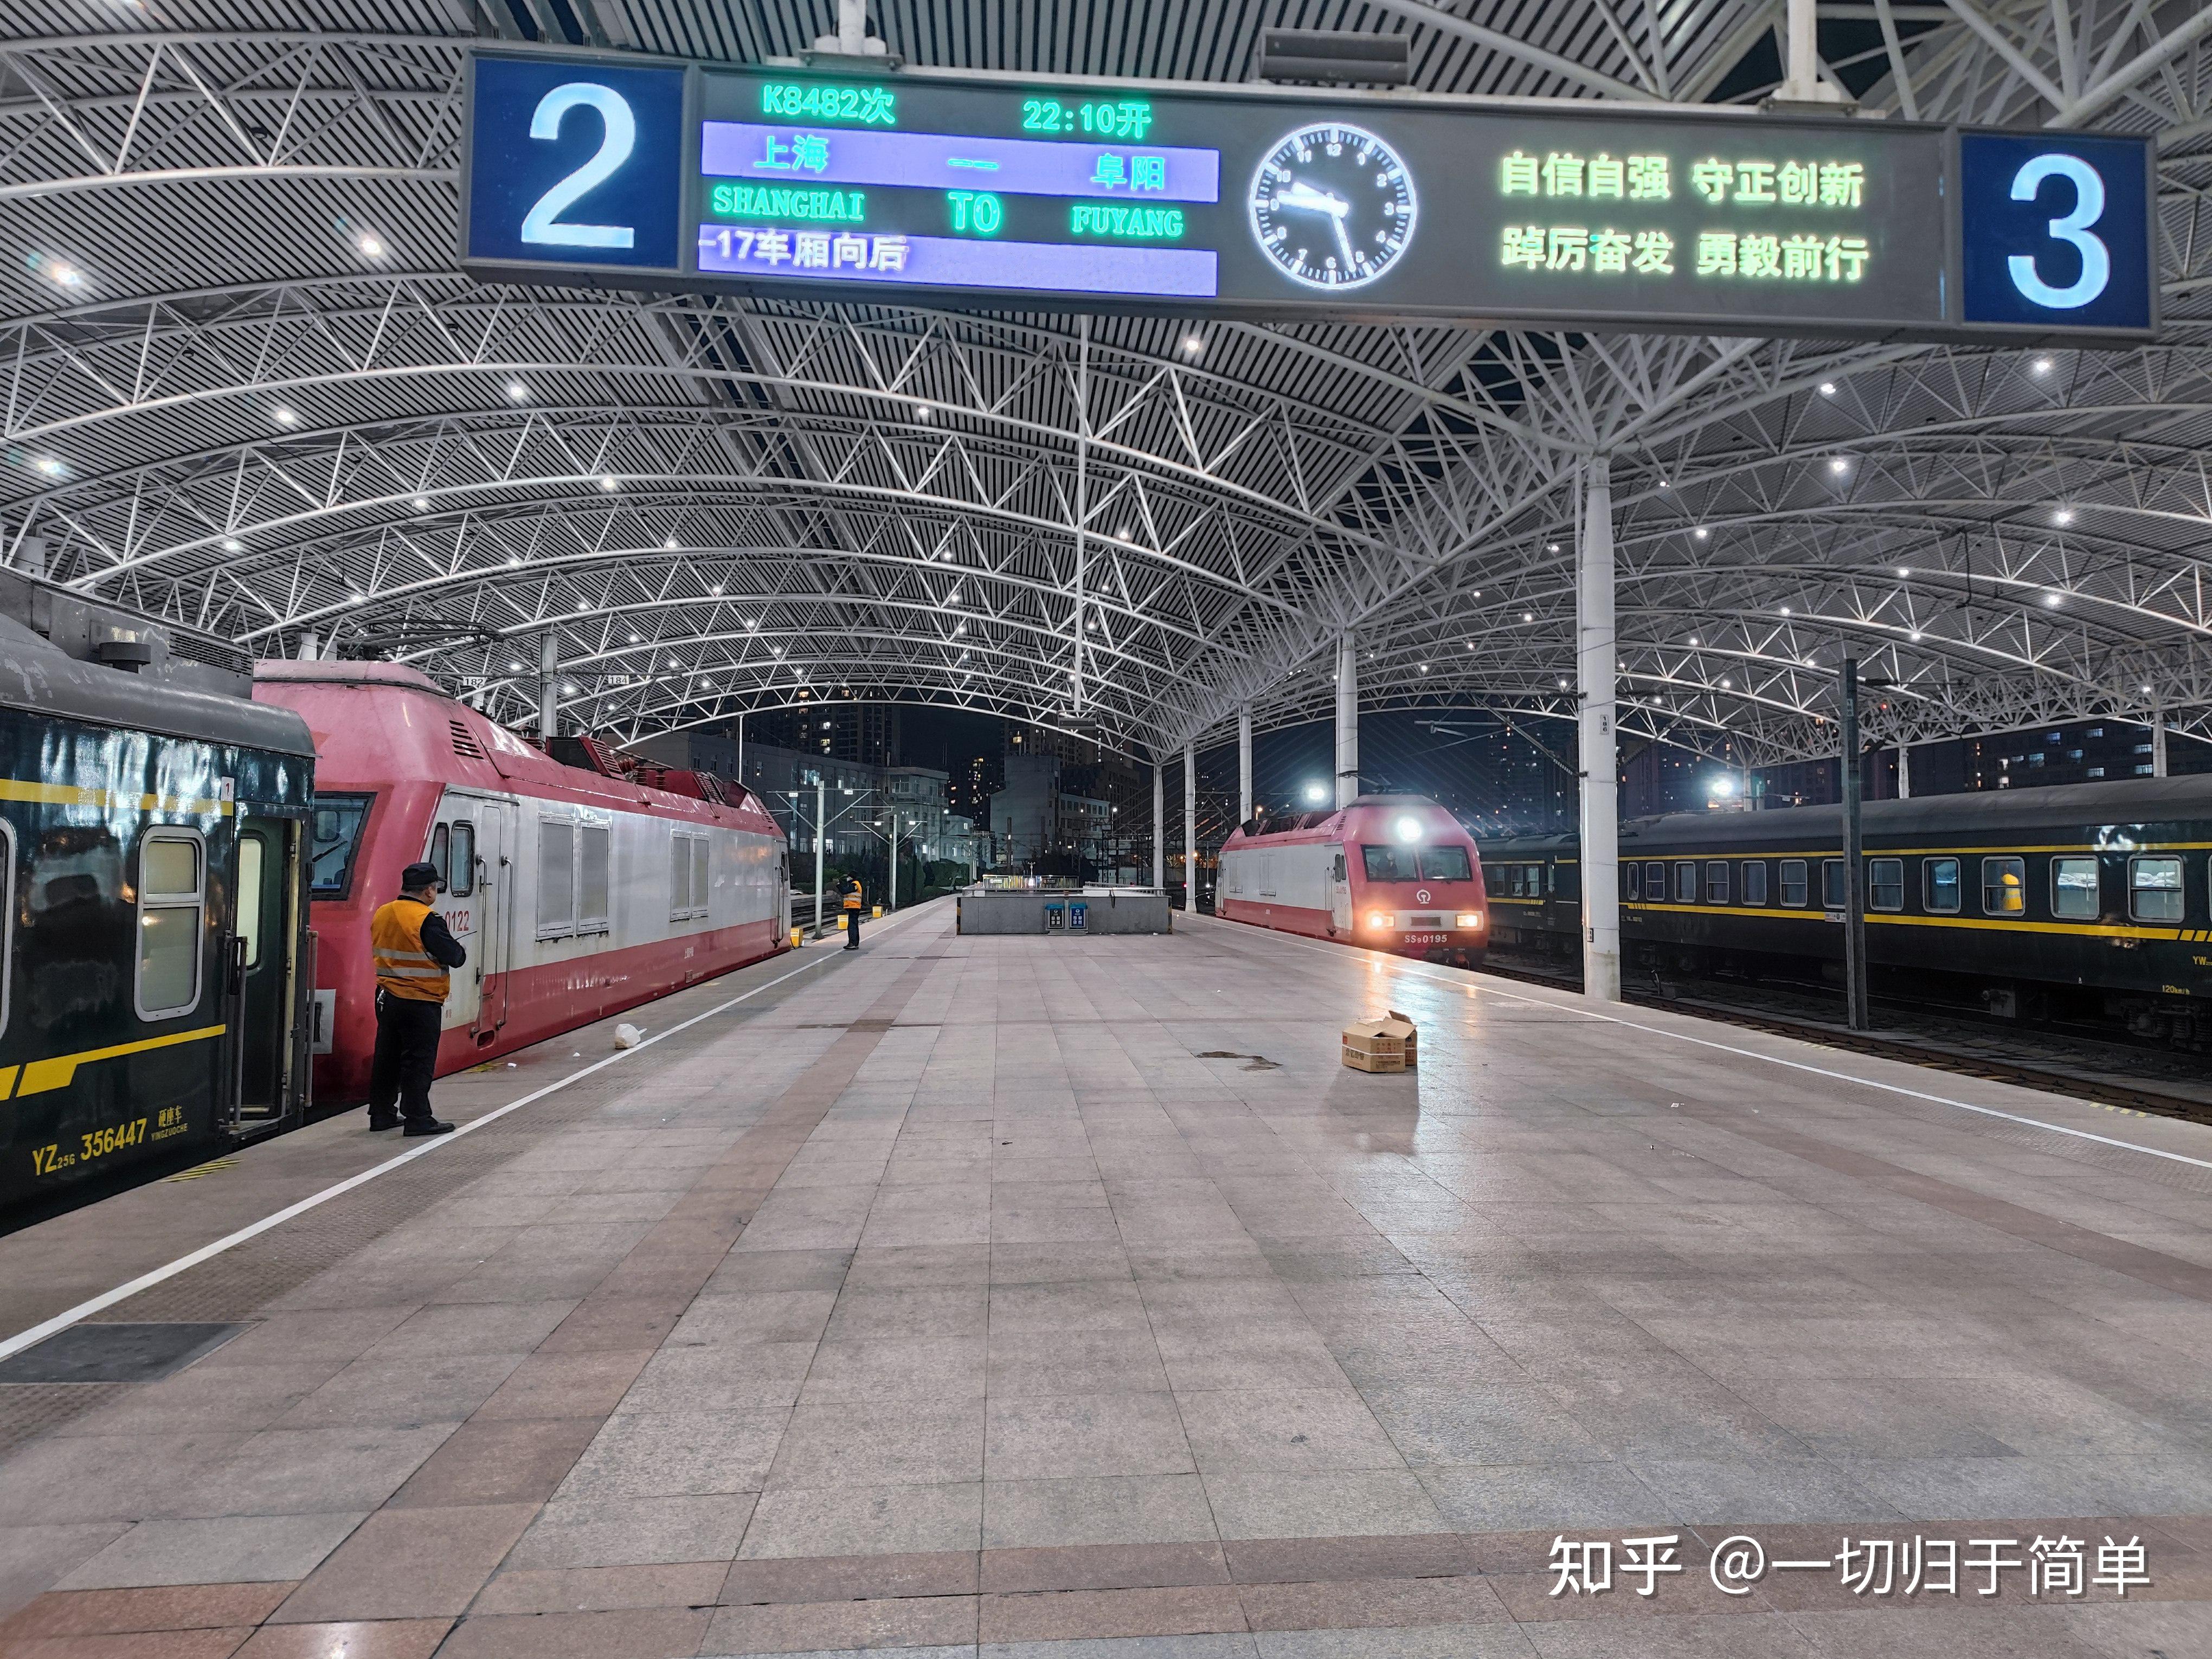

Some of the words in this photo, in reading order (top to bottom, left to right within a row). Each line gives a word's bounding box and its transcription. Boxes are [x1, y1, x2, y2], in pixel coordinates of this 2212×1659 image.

[763, 85, 895, 124] K8482次
[1023, 100, 1152, 139] 22:10开
[521, 82, 636, 249] 2
[754, 134, 828, 172] 上海
[1091, 153, 1165, 191] 阜阳
[1326, 144, 1342, 156] 12
[1358, 152, 1365, 165] 1
[1377, 173, 1387, 187] 2
[1502, 151, 1670, 200] 自信自强
[1692, 158, 1863, 207] 守正创新
[713, 185, 865, 221] SHANGHAI
[948, 192, 1001, 232] TO
[1072, 206, 1184, 236] FUYANG
[1385, 202, 1394, 215] 3
[1376, 230, 1386, 243] 4
[2008, 153, 2111, 309] 3
[1298, 248, 1307, 260] 7
[1501, 226, 1674, 273] 踔厉奋发
[1697, 233, 1869, 280] 勇毅前行
[465, 678, 484, 687] 182
[81, 1118, 147, 1160] 356447
